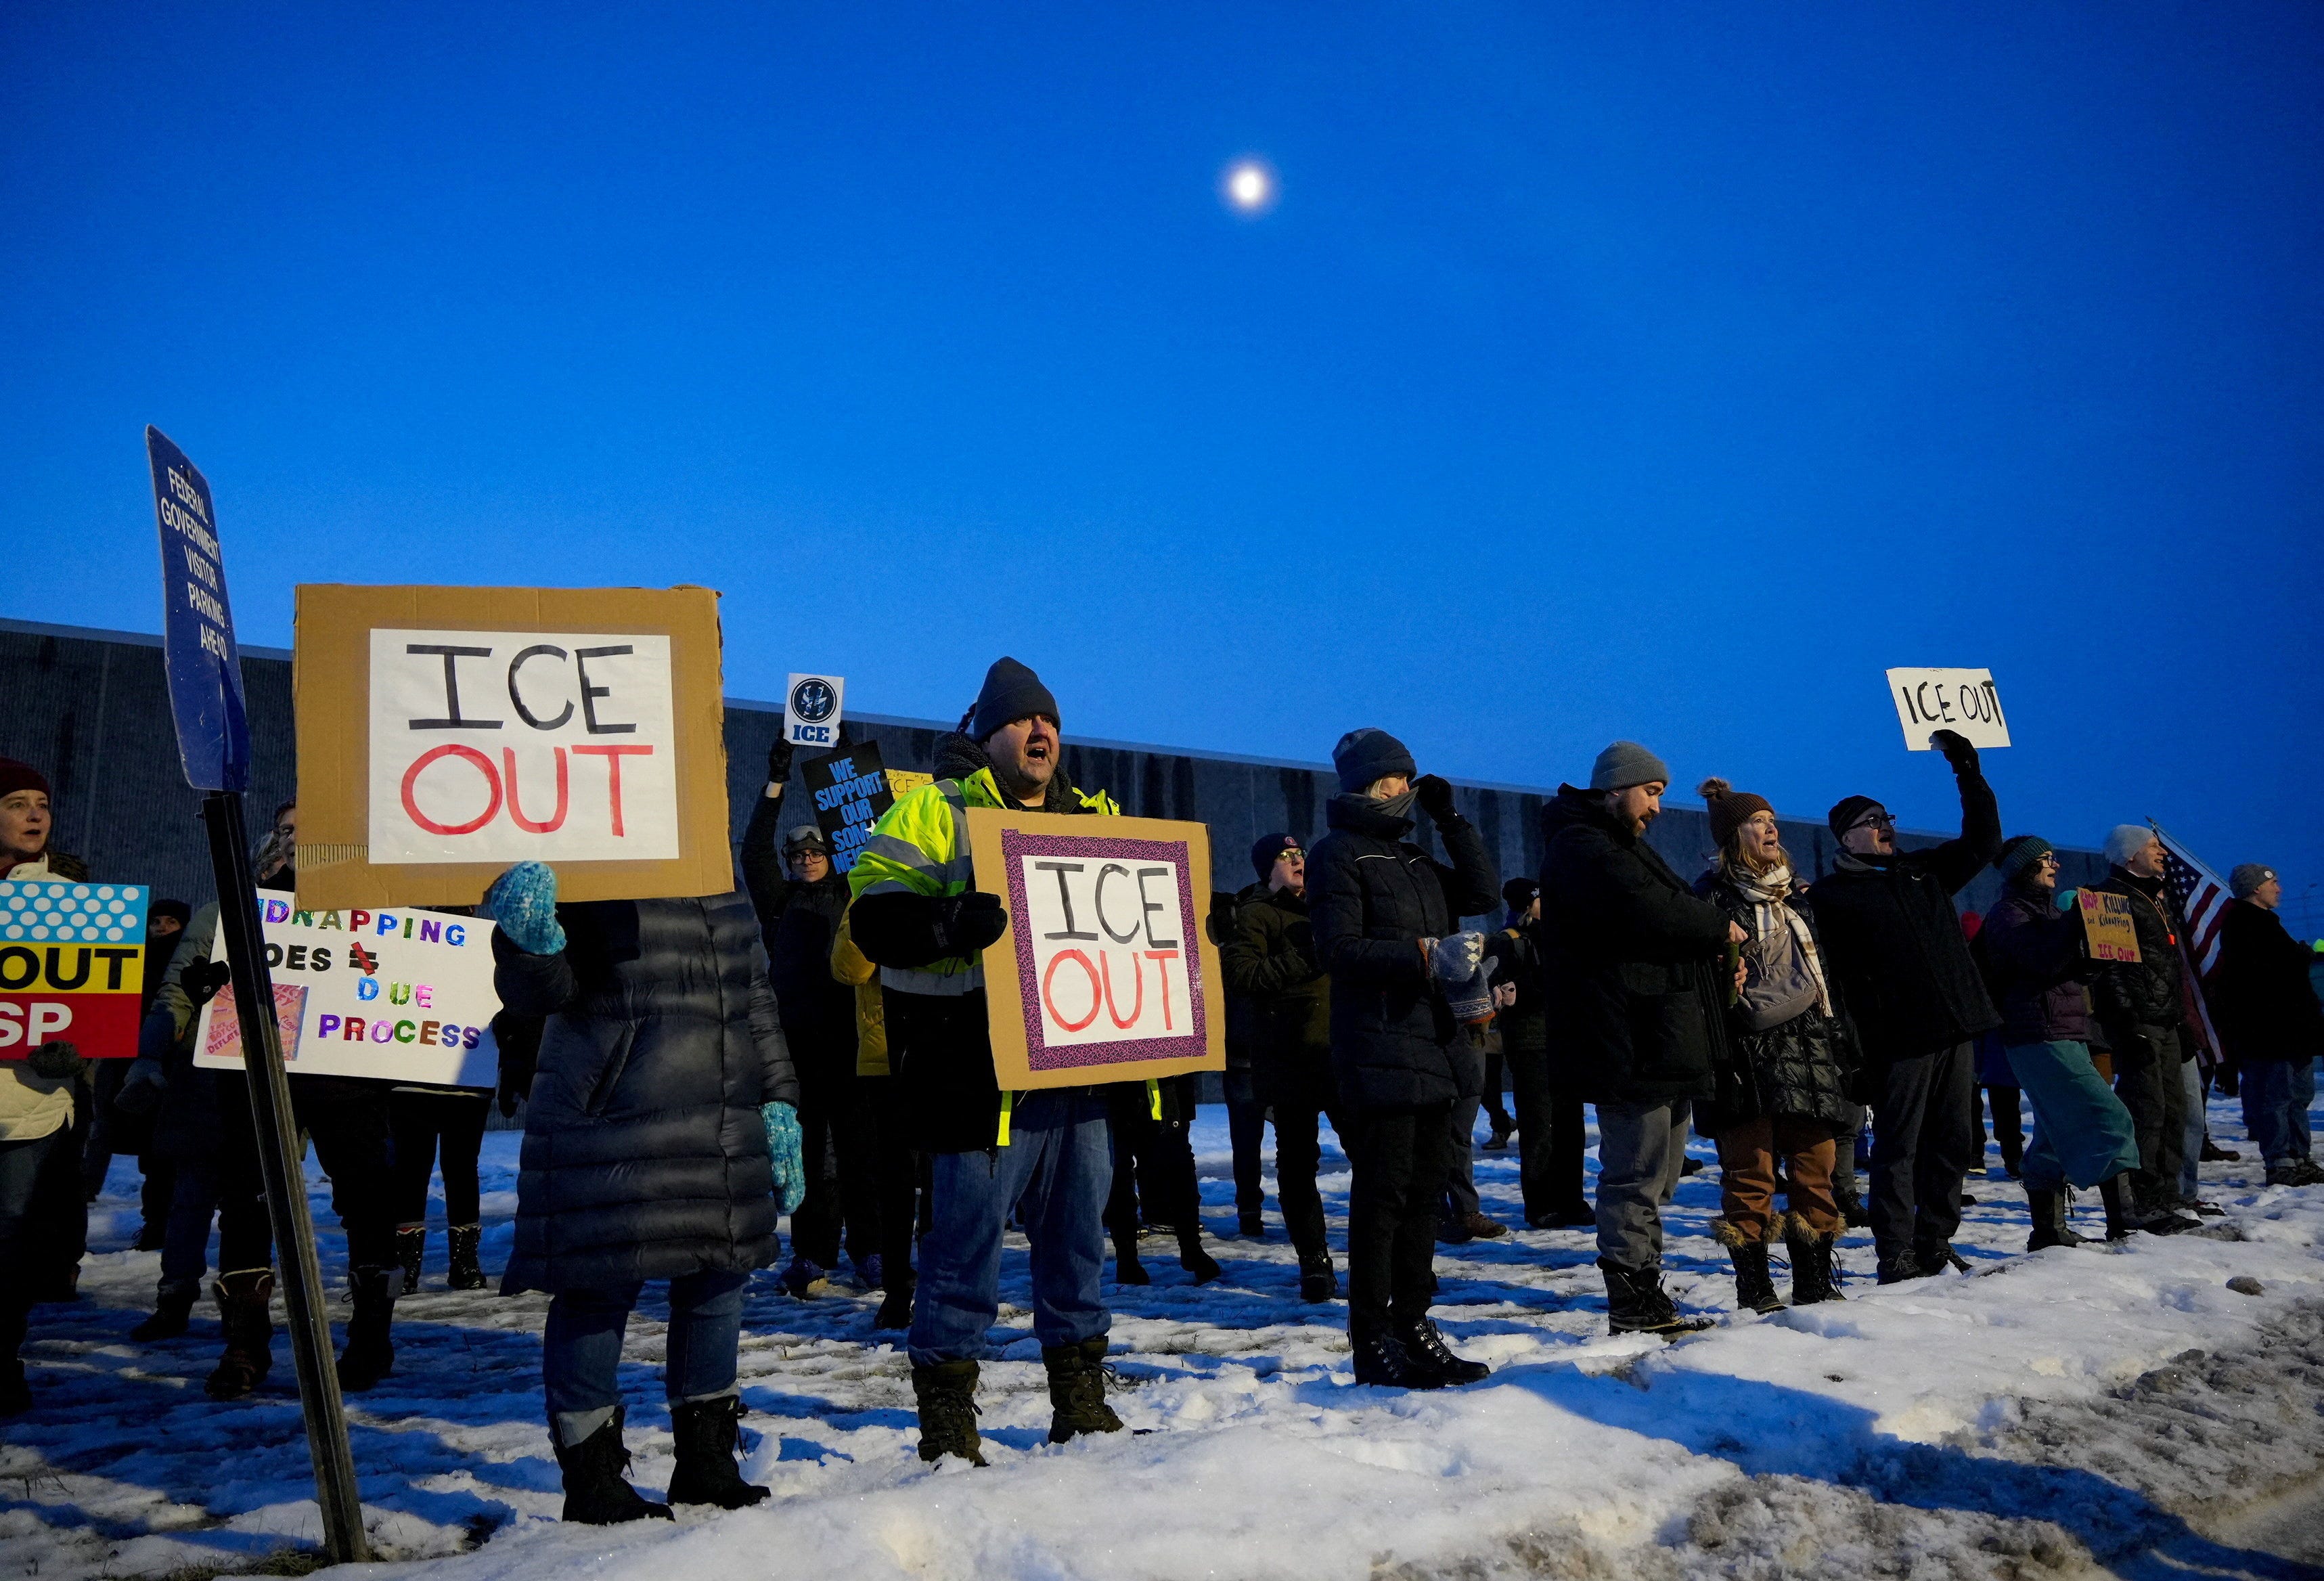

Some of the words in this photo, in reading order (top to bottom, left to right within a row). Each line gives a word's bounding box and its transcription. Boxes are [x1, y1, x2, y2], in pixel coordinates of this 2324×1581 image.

[167, 466, 208, 525] FEDERAL
[160, 497, 220, 565] GOVERNMENT
[184, 545, 218, 593] VISITOR
[187, 581, 225, 628] PARKING
[200, 623, 227, 661] AHEAD
[406, 644, 636, 734] ICE
[1902, 681, 1956, 724] ICE
[1960, 680, 2002, 727] OUT
[792, 725, 830, 742] ICE
[401, 744, 653, 837] OUT
[815, 771, 883, 811] SUPPORT
[828, 757, 858, 783] WE
[841, 798, 874, 825] OUR
[831, 822, 870, 851] SOM
[256, 898, 465, 947] IDNAPPING
[1035, 861, 1178, 948] ICE
[0, 946, 138, 990] OUT
[265, 943, 332, 971] OES
[2097, 943, 2114, 958] ICE
[357, 977, 433, 1008] DUE
[1042, 949, 1178, 1032] OUT
[207, 1029, 240, 1054] DEFLATE
[318, 1014, 481, 1049] PROCESS
